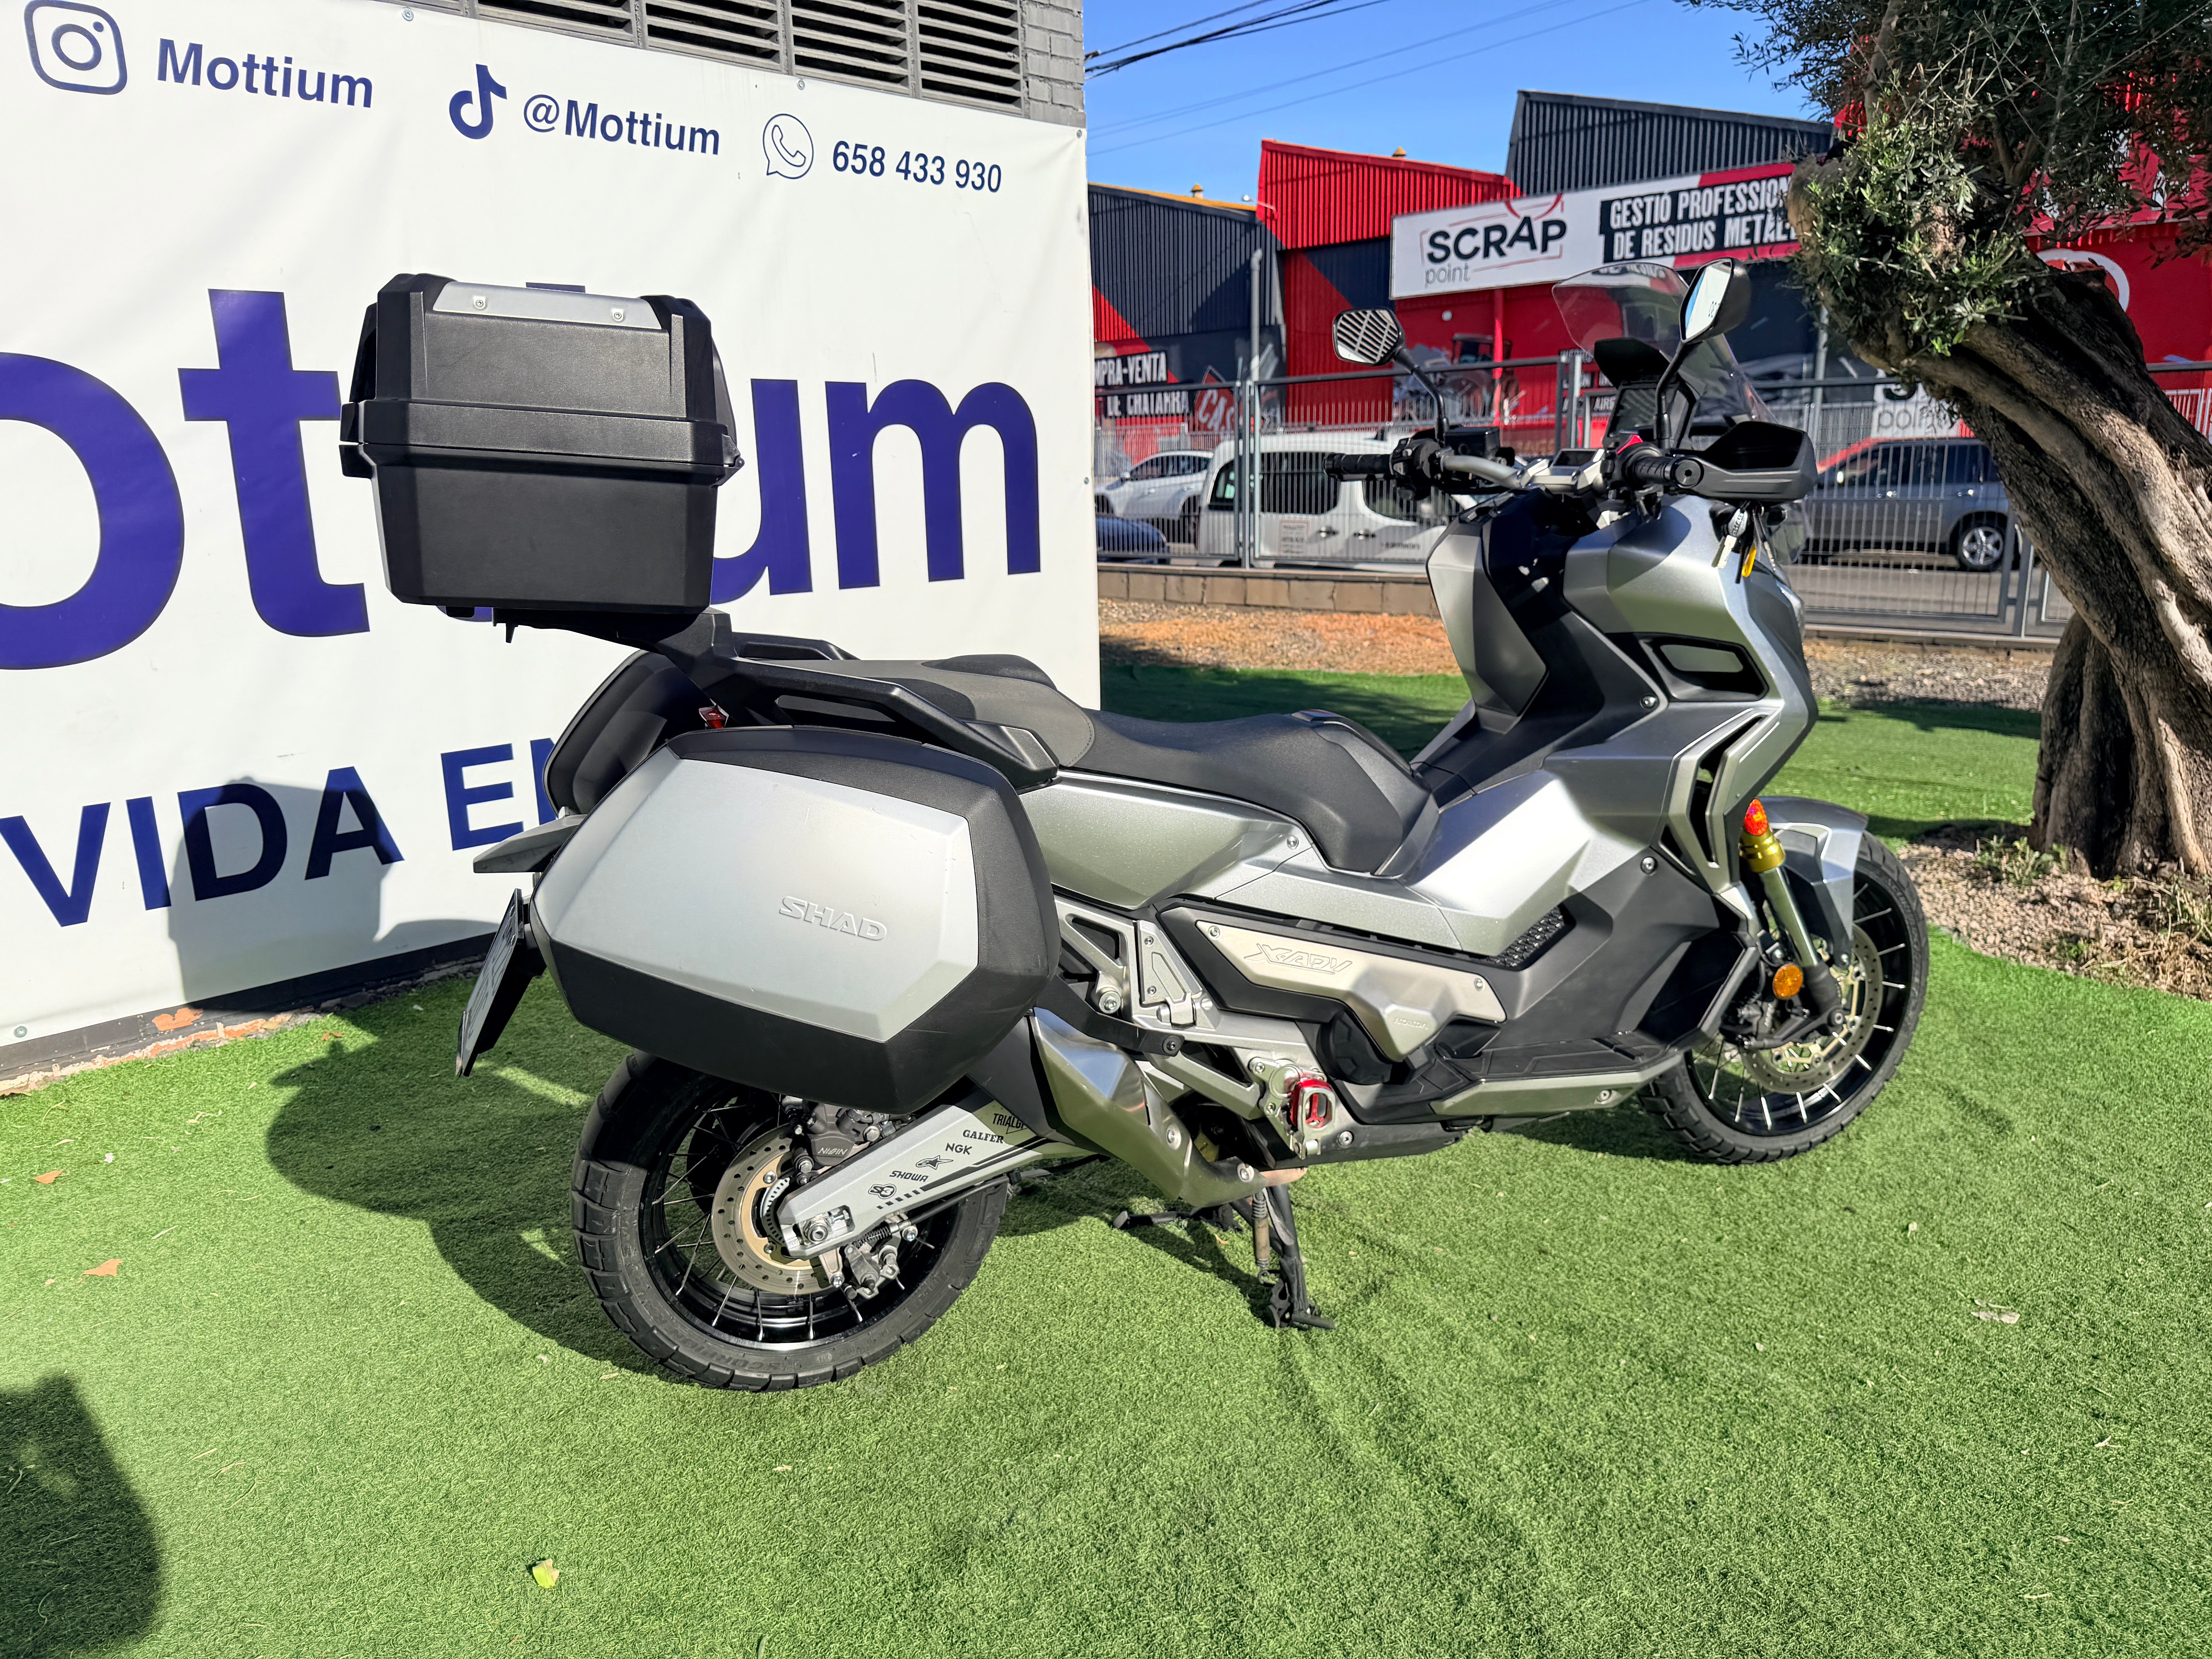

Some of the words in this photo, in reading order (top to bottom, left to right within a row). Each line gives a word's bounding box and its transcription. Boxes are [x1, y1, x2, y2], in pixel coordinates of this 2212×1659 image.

[157, 38, 373, 108] Mottium
[524, 94, 720, 155] @Mottium
[833, 141, 885, 177] 658
[895, 151, 945, 185] 433
[955, 159, 1001, 193] 930
[1427, 216, 1567, 264] SCRAP
[1613, 230, 1636, 261] DE
[1641, 220, 1716, 257] RESIDUS
[1424, 262, 1471, 289] point
[0, 766, 404, 927] VIDA
[779, 895, 888, 941] SHAD
[945, 1142, 972, 1155] NGK
[963, 1129, 1004, 1144] GALFER
[889, 1170, 929, 1182] SHOWA
